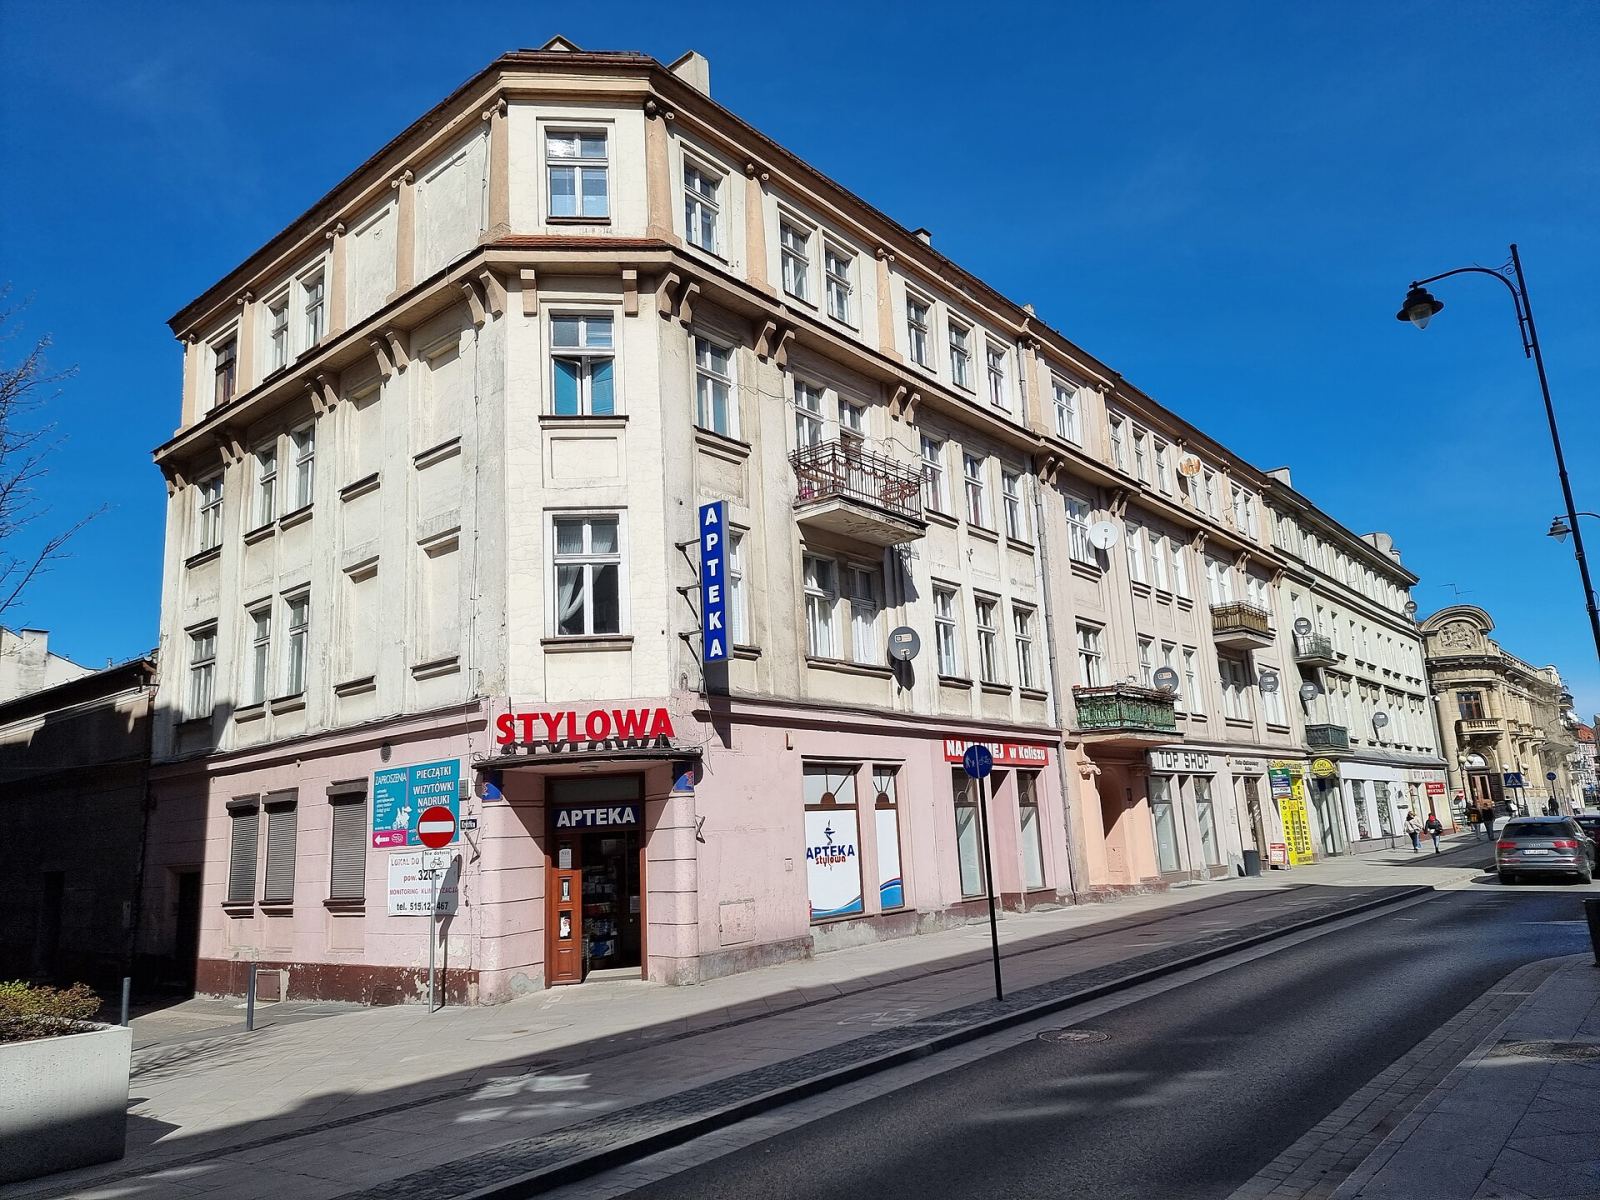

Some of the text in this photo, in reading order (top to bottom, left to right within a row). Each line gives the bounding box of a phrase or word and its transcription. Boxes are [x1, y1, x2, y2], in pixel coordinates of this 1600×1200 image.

[705, 507, 722, 657] APTEKA
[496, 708, 675, 744] STYLOWA
[1018, 745, 1046, 760] Kaliszu
[1158, 751, 1209, 769] TOP SHOP
[375, 772, 407, 785] ZAPROSZENIA
[416, 766, 451, 779] PIECZĄTKI
[413, 780, 454, 795] WIZYTÓWKI
[417, 795, 450, 806] NADRUKI
[557, 807, 635, 827] APTEKA
[806, 845, 855, 859] APTEKA
[391, 858, 409, 866] LOKAL
[815, 855, 846, 867] stylowa
[404, 875, 418, 883] pow.
[396, 902, 407, 910] tel.
